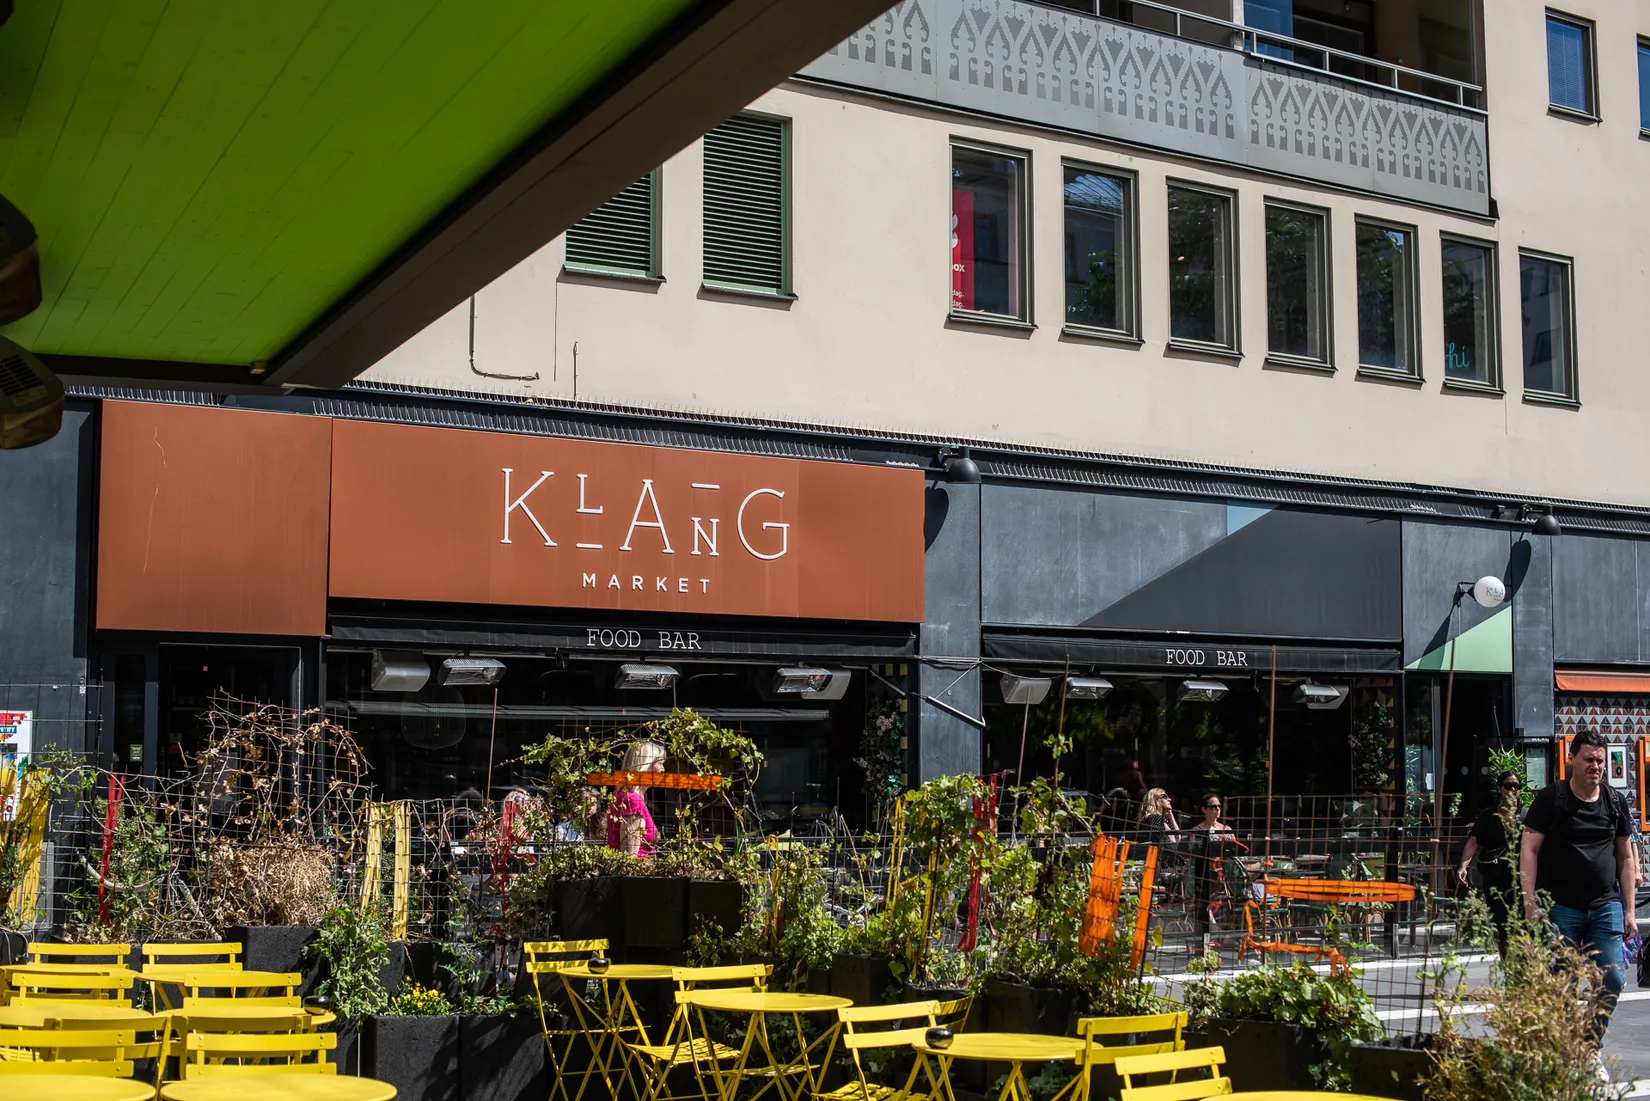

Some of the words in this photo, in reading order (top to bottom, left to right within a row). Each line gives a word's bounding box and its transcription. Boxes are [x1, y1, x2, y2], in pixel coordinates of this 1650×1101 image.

[951, 263, 965, 272] ox
[1445, 342, 1470, 369] hi
[499, 467, 791, 561] KLANG
[582, 572, 710, 594] MARKET
[586, 628, 642, 648] FOOD
[658, 631, 702, 650] BAR
[1165, 648, 1206, 666] FOOD
[1216, 649, 1249, 667] BAR
